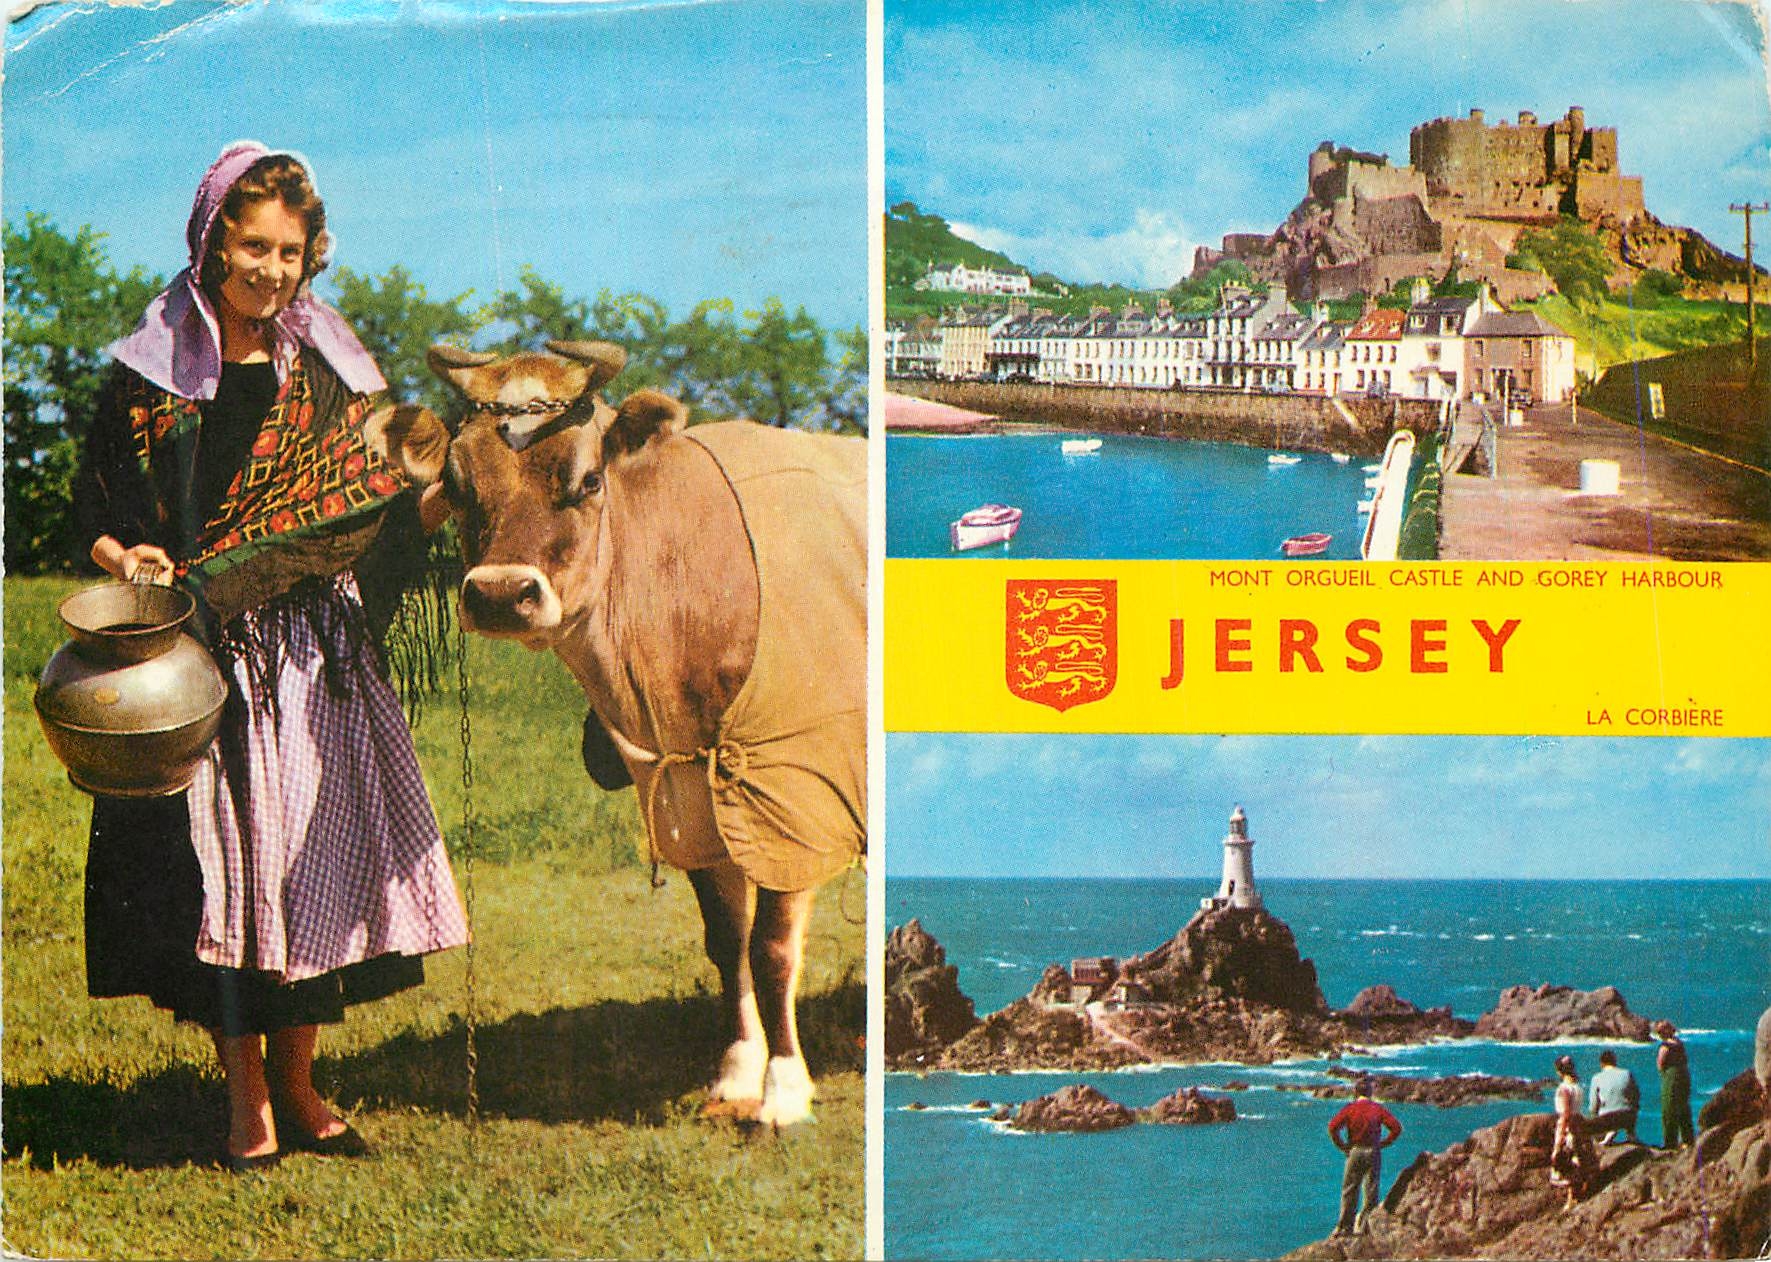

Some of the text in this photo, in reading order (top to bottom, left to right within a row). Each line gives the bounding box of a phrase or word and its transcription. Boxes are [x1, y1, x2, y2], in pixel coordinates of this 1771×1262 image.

[1210, 569, 1723, 588] MONT ORGUEIL CASTLE AND GOREY HARBOUR
[1160, 618, 1522, 691] JERSEY
[1587, 709, 1612, 726] LA
